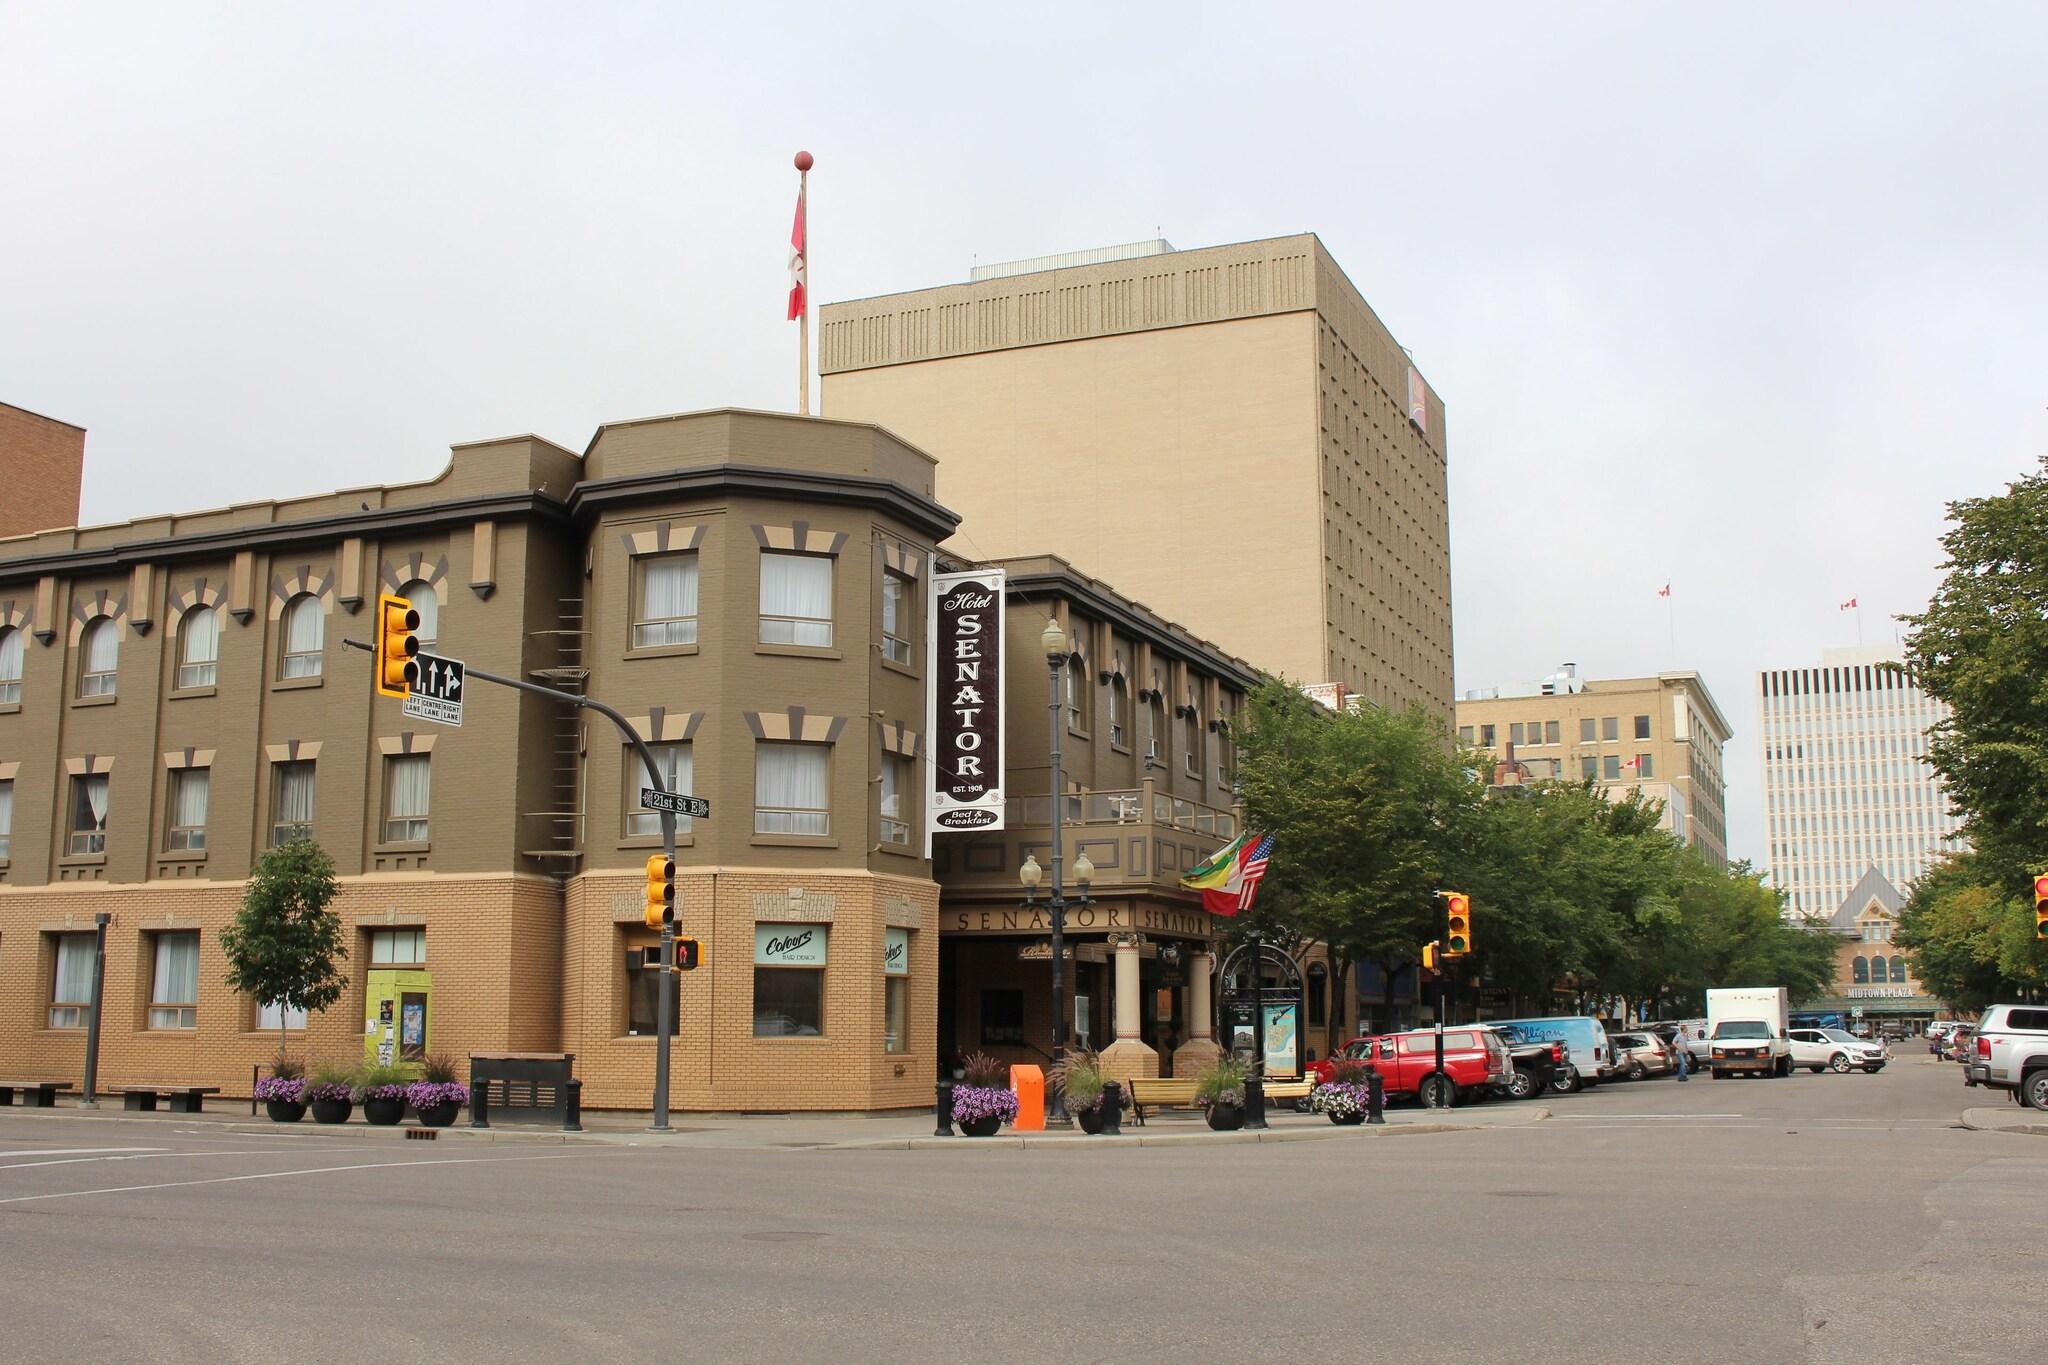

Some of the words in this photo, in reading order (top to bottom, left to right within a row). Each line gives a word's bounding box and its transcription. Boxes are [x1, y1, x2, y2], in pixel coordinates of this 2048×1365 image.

[944, 592, 993, 611] Hotel
[952, 614, 984, 776] SENATOR
[406, 704, 420, 712] LANE
[423, 700, 441, 710] CENTRE
[443, 704, 459, 712] RIGHT
[424, 709, 438, 717] LANE
[444, 712, 458, 720] LANE
[967, 784, 983, 792] 1908
[653, 794, 673, 808] 21st
[676, 798, 687, 812] St
[690, 800, 698, 813] E
[951, 810, 972, 819] Bed
[944, 816, 991, 826] Breakfast
[958, 908, 1121, 930] SENAOR
[1145, 910, 1203, 934] SENATOR
[766, 930, 812, 955] Colours
[1848, 988, 1886, 998] MIDTOWN
[1887, 988, 1913, 998] PLAZA
